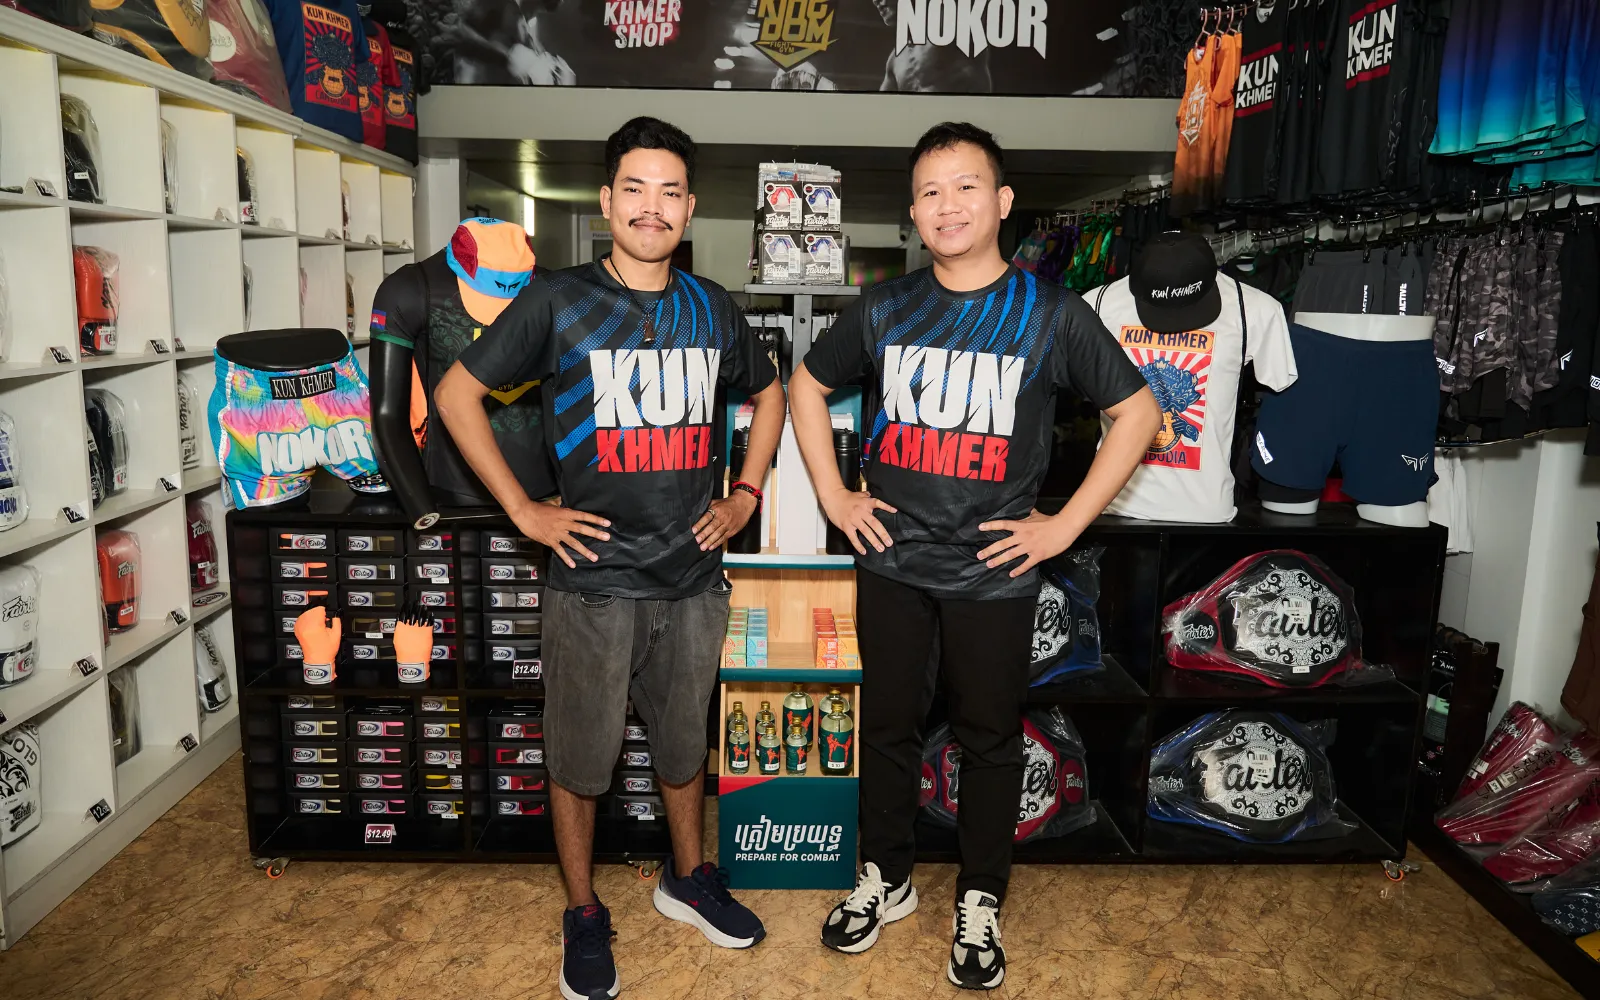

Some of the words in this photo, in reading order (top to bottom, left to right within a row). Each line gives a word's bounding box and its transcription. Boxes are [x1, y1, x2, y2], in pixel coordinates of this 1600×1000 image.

[306, 6, 325, 20] KUN
[326, 12, 350, 31] KHMER
[604, 0, 682, 26] KHMER
[614, 23, 674, 49] SHOP
[895, 0, 1048, 59] NOKOR
[1347, 4, 1397, 58] KUN
[1236, 54, 1279, 92] KUN
[1151, 286, 1170, 299] KUN
[1171, 281, 1203, 298] KHMER
[1124, 328, 1154, 345] KUN
[1157, 331, 1208, 349] KHMER
[272, 378, 298, 398] KUN
[299, 370, 336, 396] KHMER
[589, 348, 721, 428] KUN
[882, 345, 1025, 437] KUN
[257, 420, 374, 476] NOKOR
[878, 423, 1010, 482] KHMER
[514, 665, 539, 675] $12.49
[366, 829, 391, 838] $12.49
[735, 853, 777, 861] PREPARE
[780, 853, 798, 861] FOR
[800, 853, 841, 862] COMBAT
